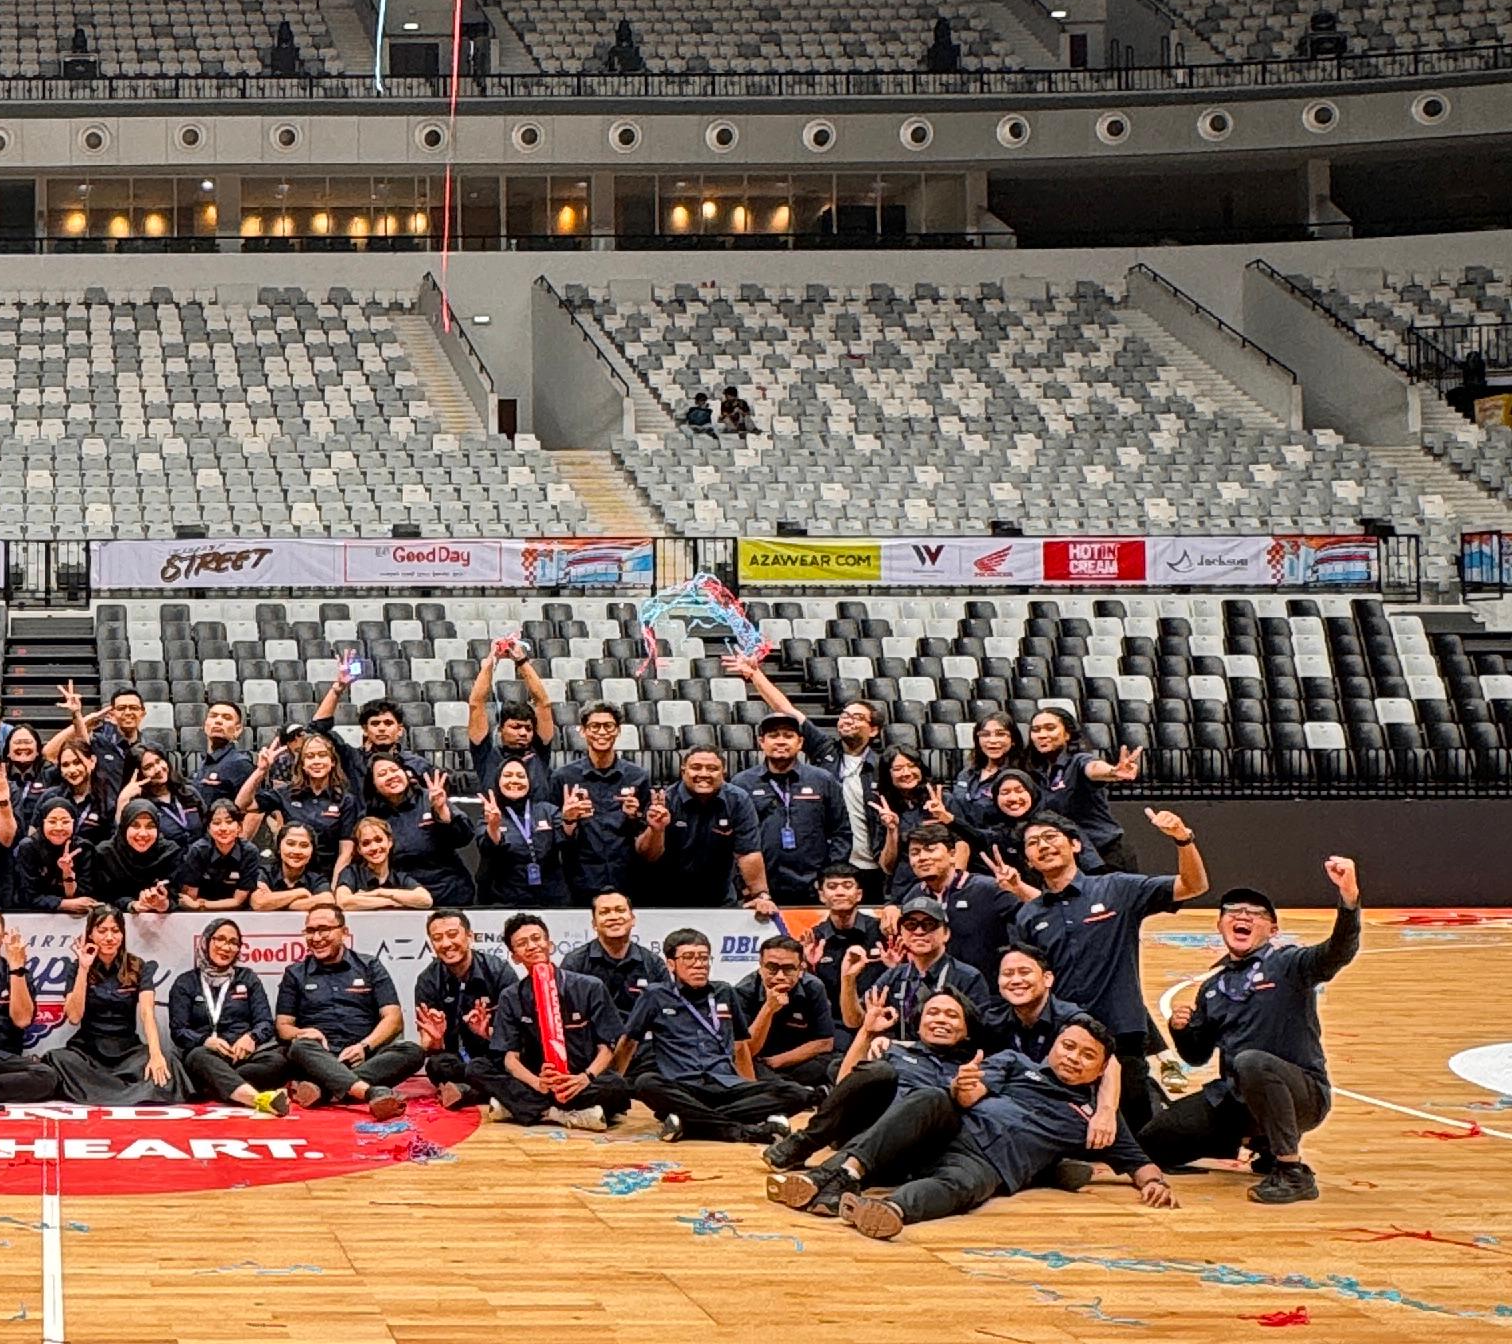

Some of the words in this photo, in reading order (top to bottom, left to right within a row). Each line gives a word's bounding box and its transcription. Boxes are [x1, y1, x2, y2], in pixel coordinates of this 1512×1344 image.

[160, 548, 274, 583] STREET
[392, 546, 436, 563] Good
[438, 546, 472, 567] Day
[1069, 560, 1120, 574] CREAM
